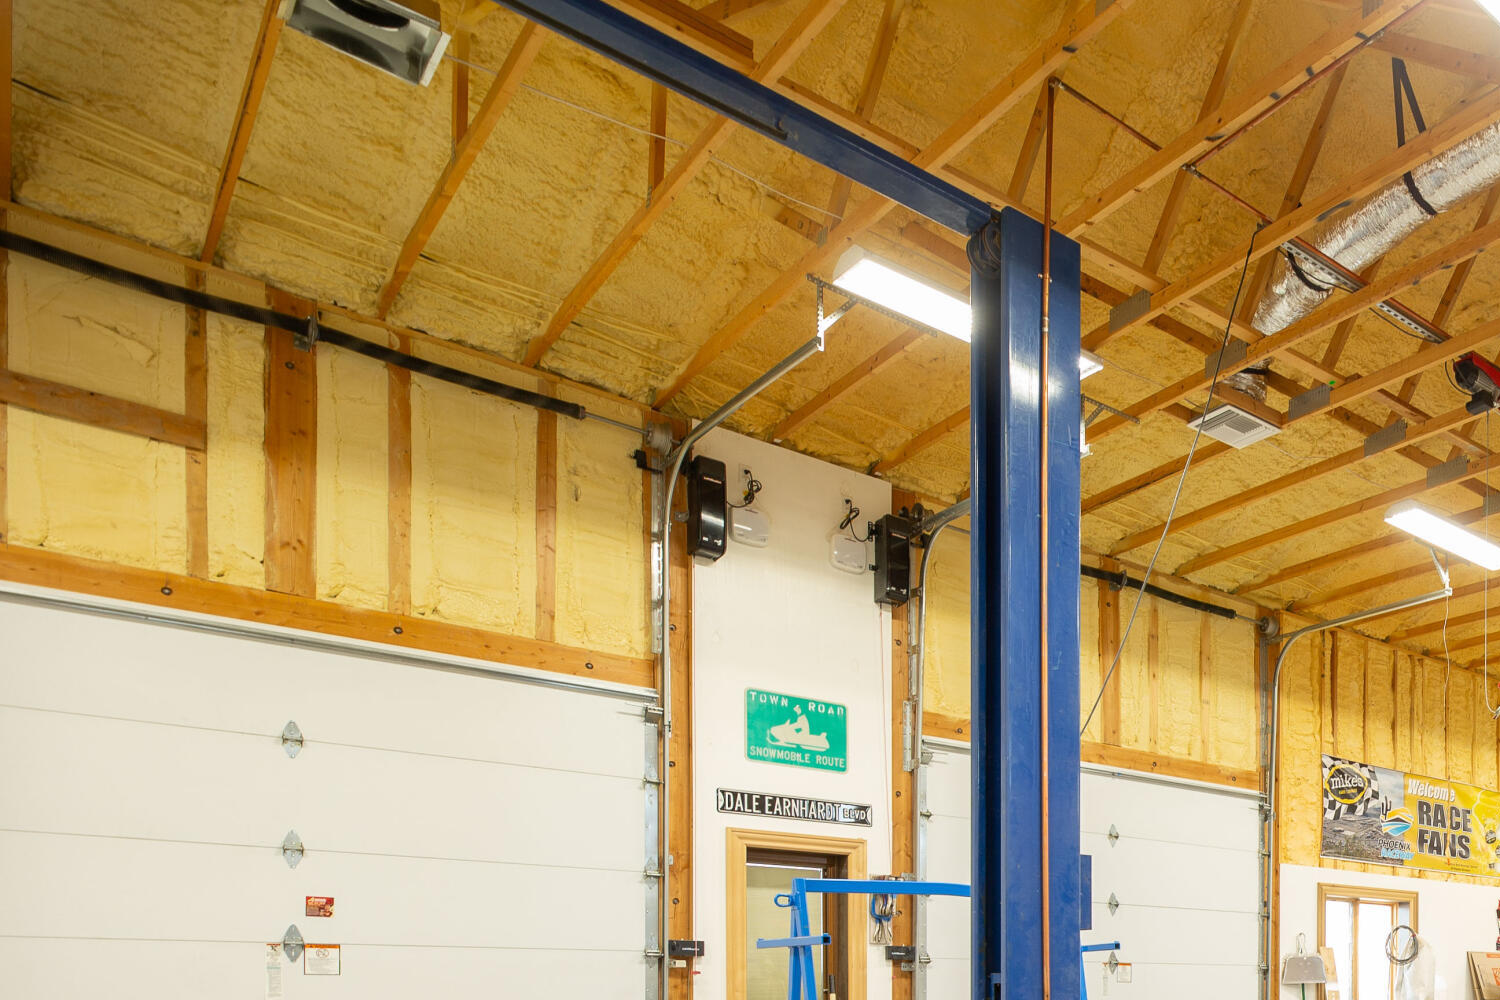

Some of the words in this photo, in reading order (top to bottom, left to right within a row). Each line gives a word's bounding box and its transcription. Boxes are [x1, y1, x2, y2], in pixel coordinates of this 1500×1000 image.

[749, 691, 789, 707] TOWN
[808, 702, 844, 716] ROAD
[750, 745, 811, 764] SNOWMOBILE
[816, 755, 845, 768] ROUTE
[1407, 778, 1456, 802] Welcome
[725, 791, 761, 814] DALE
[765, 796, 841, 821] EARNHARDT
[843, 807, 866, 820] BLVD
[1417, 800, 1473, 833] RACE
[1378, 839, 1411, 850] PHOENIX
[1417, 828, 1471, 860] FANS
